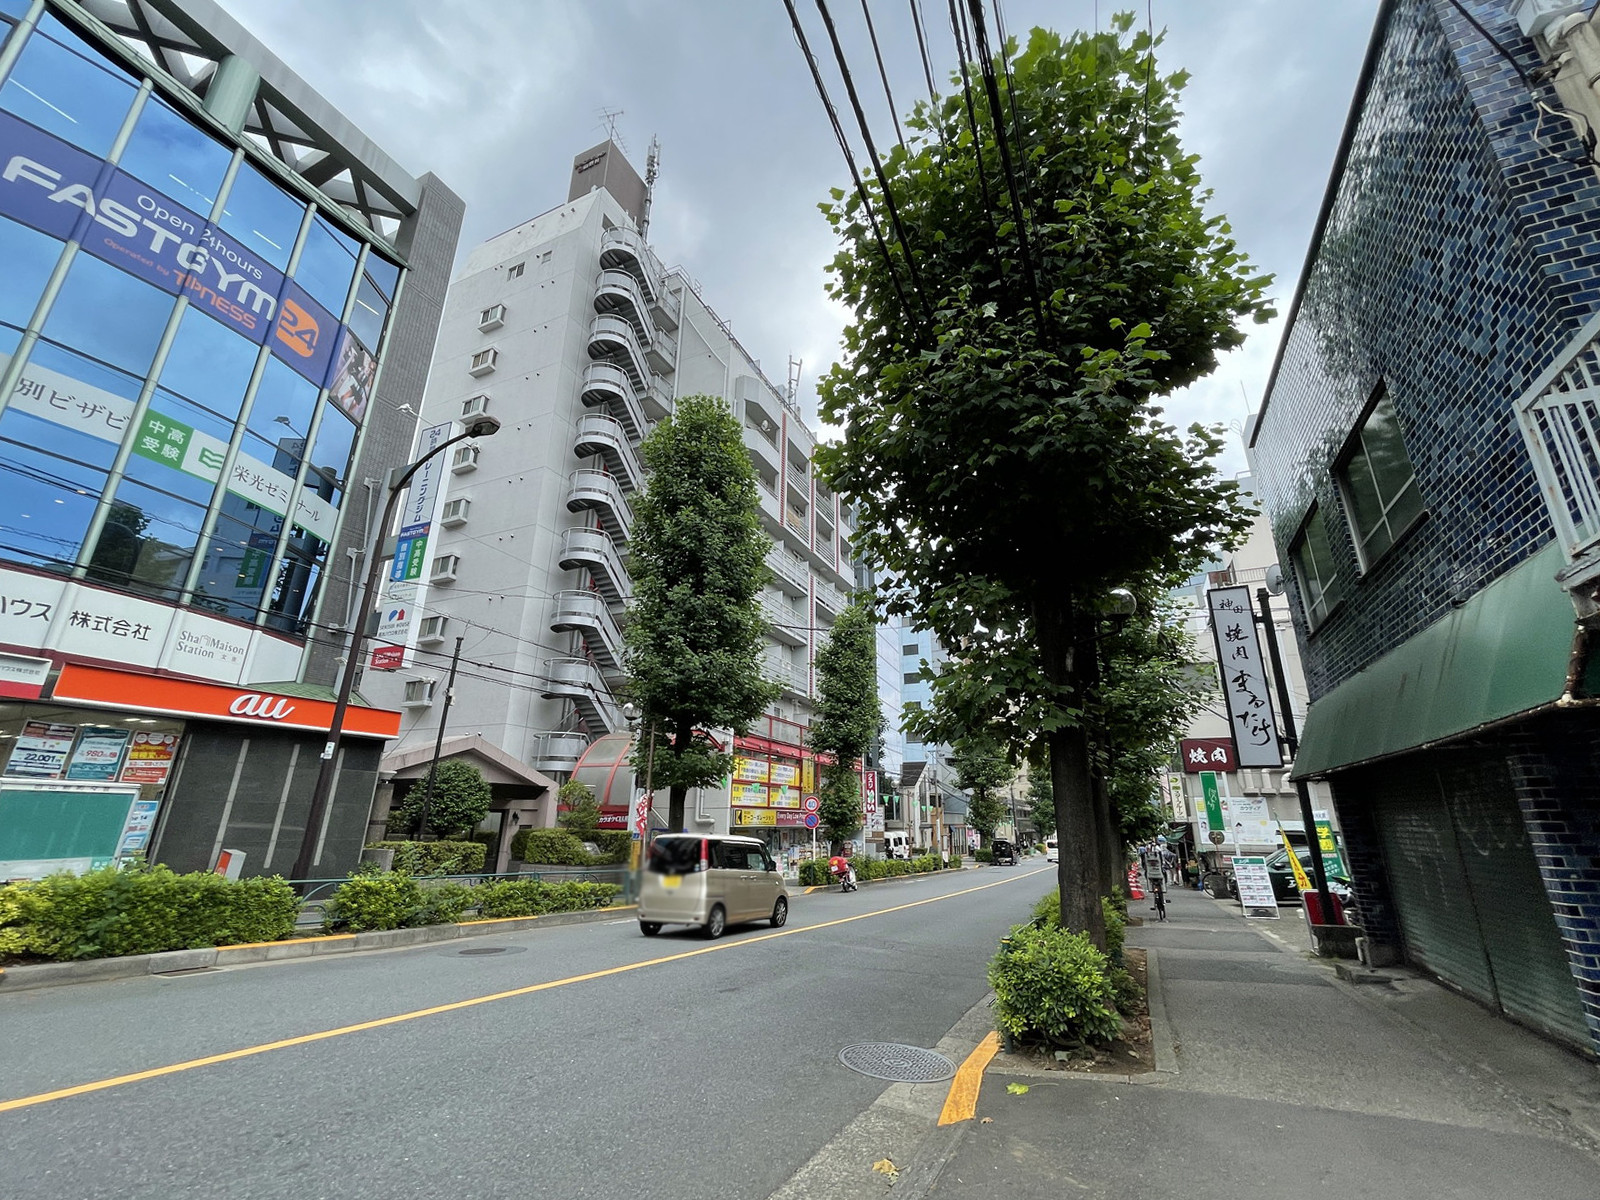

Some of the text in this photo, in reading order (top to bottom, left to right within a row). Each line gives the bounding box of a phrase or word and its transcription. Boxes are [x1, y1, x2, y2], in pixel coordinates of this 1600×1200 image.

[137, 195, 195, 235] Open
[2, 156, 319, 356] FASTGYM 24
[103, 238, 153, 266] Operated
[148, 419, 187, 446] 中高
[141, 434, 182, 462] 受験
[1219, 598, 1243, 614] 神田
[69, 610, 152, 641] 株式会社
[176, 641, 214, 658] Station
[1225, 623, 1249, 660] 焼肉
[229, 694, 296, 719] au
[1189, 747, 1228, 764] 焼肉
